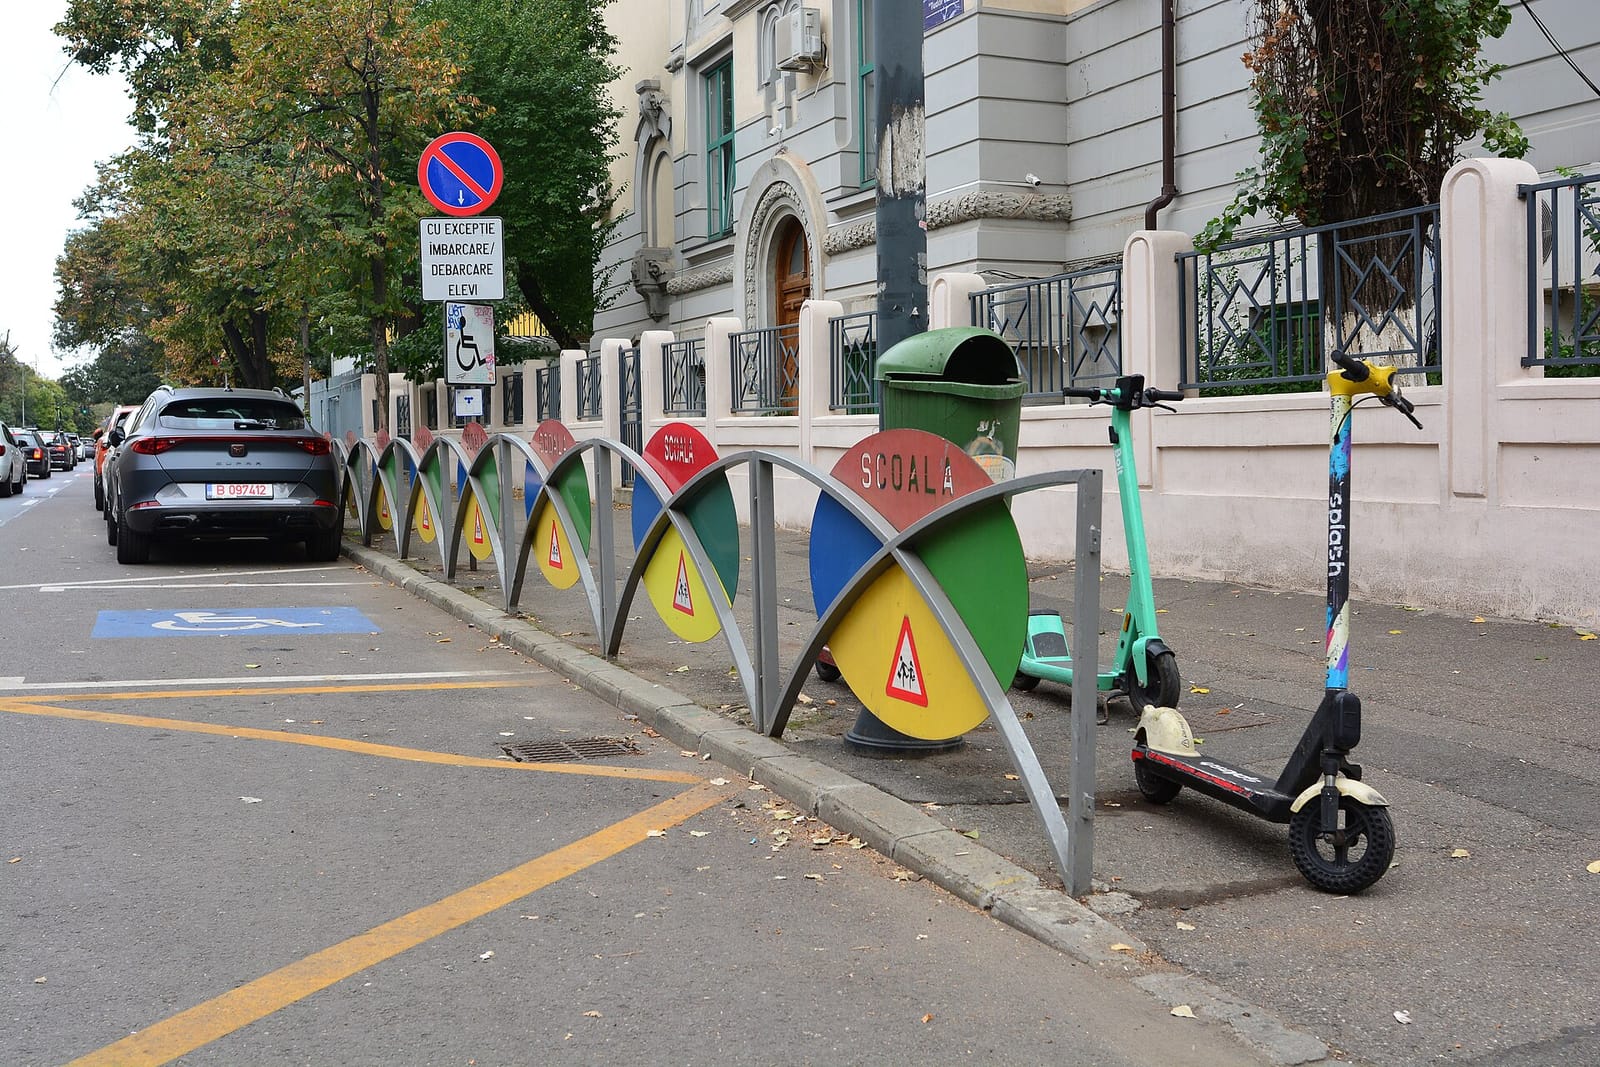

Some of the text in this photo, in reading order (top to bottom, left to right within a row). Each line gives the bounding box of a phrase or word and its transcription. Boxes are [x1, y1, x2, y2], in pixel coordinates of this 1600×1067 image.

[427, 223, 441, 235] CU
[431, 263, 494, 276] DEBARCARE
[448, 283, 478, 296] ELEVI
[664, 434, 694, 464] SCOALA
[1114, 448, 1124, 475] Bolt
[861, 452, 954, 496] SCOALA
[217, 485, 266, 495] B 097412
[1328, 493, 1346, 577] splash
